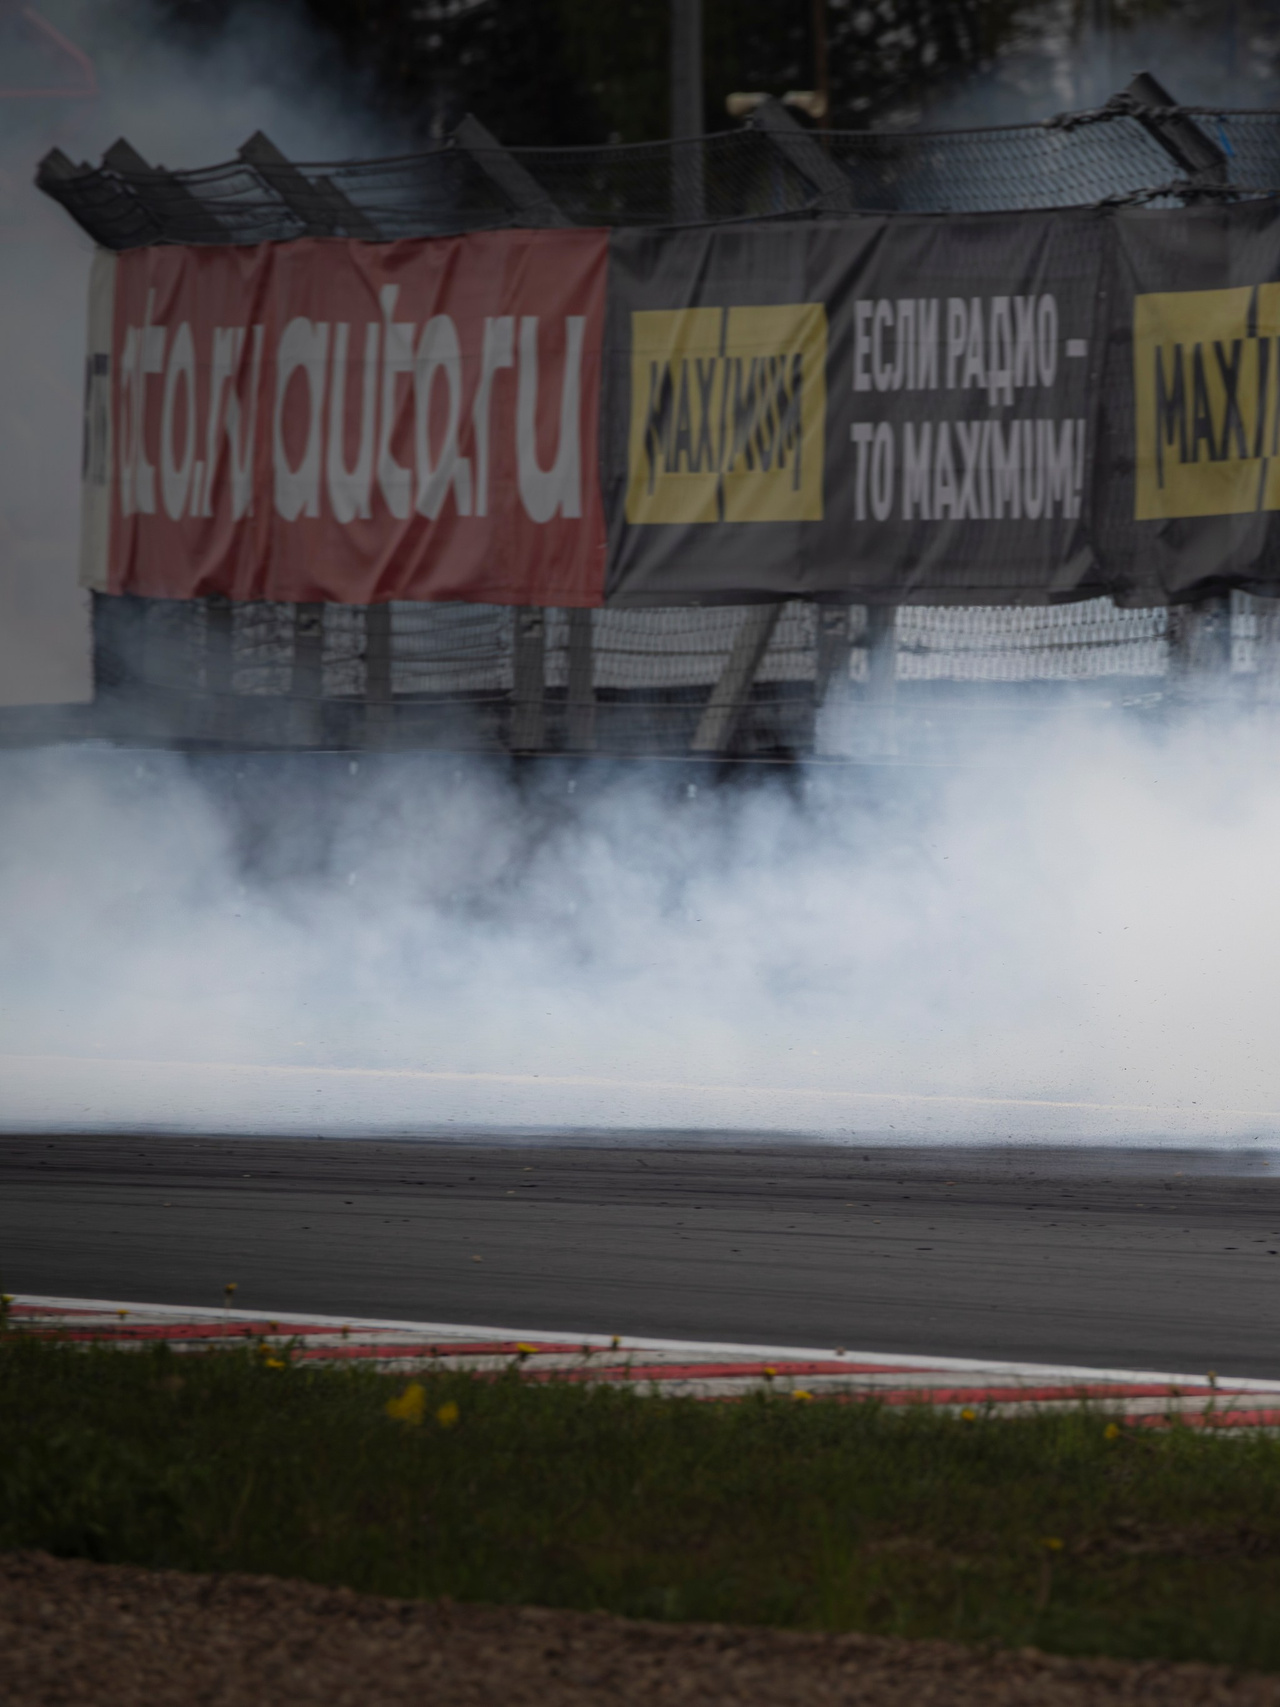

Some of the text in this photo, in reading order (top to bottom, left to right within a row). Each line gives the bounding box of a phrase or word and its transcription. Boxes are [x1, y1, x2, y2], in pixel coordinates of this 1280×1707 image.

[273, 284, 586, 525] auto.ru
[853, 298, 939, 392] ЕСЛИ
[947, 294, 1058, 406] РАДИО
[645, 353, 803, 495] MAXIMUM
[850, 418, 1087, 521] ТО MAXIMUM!
